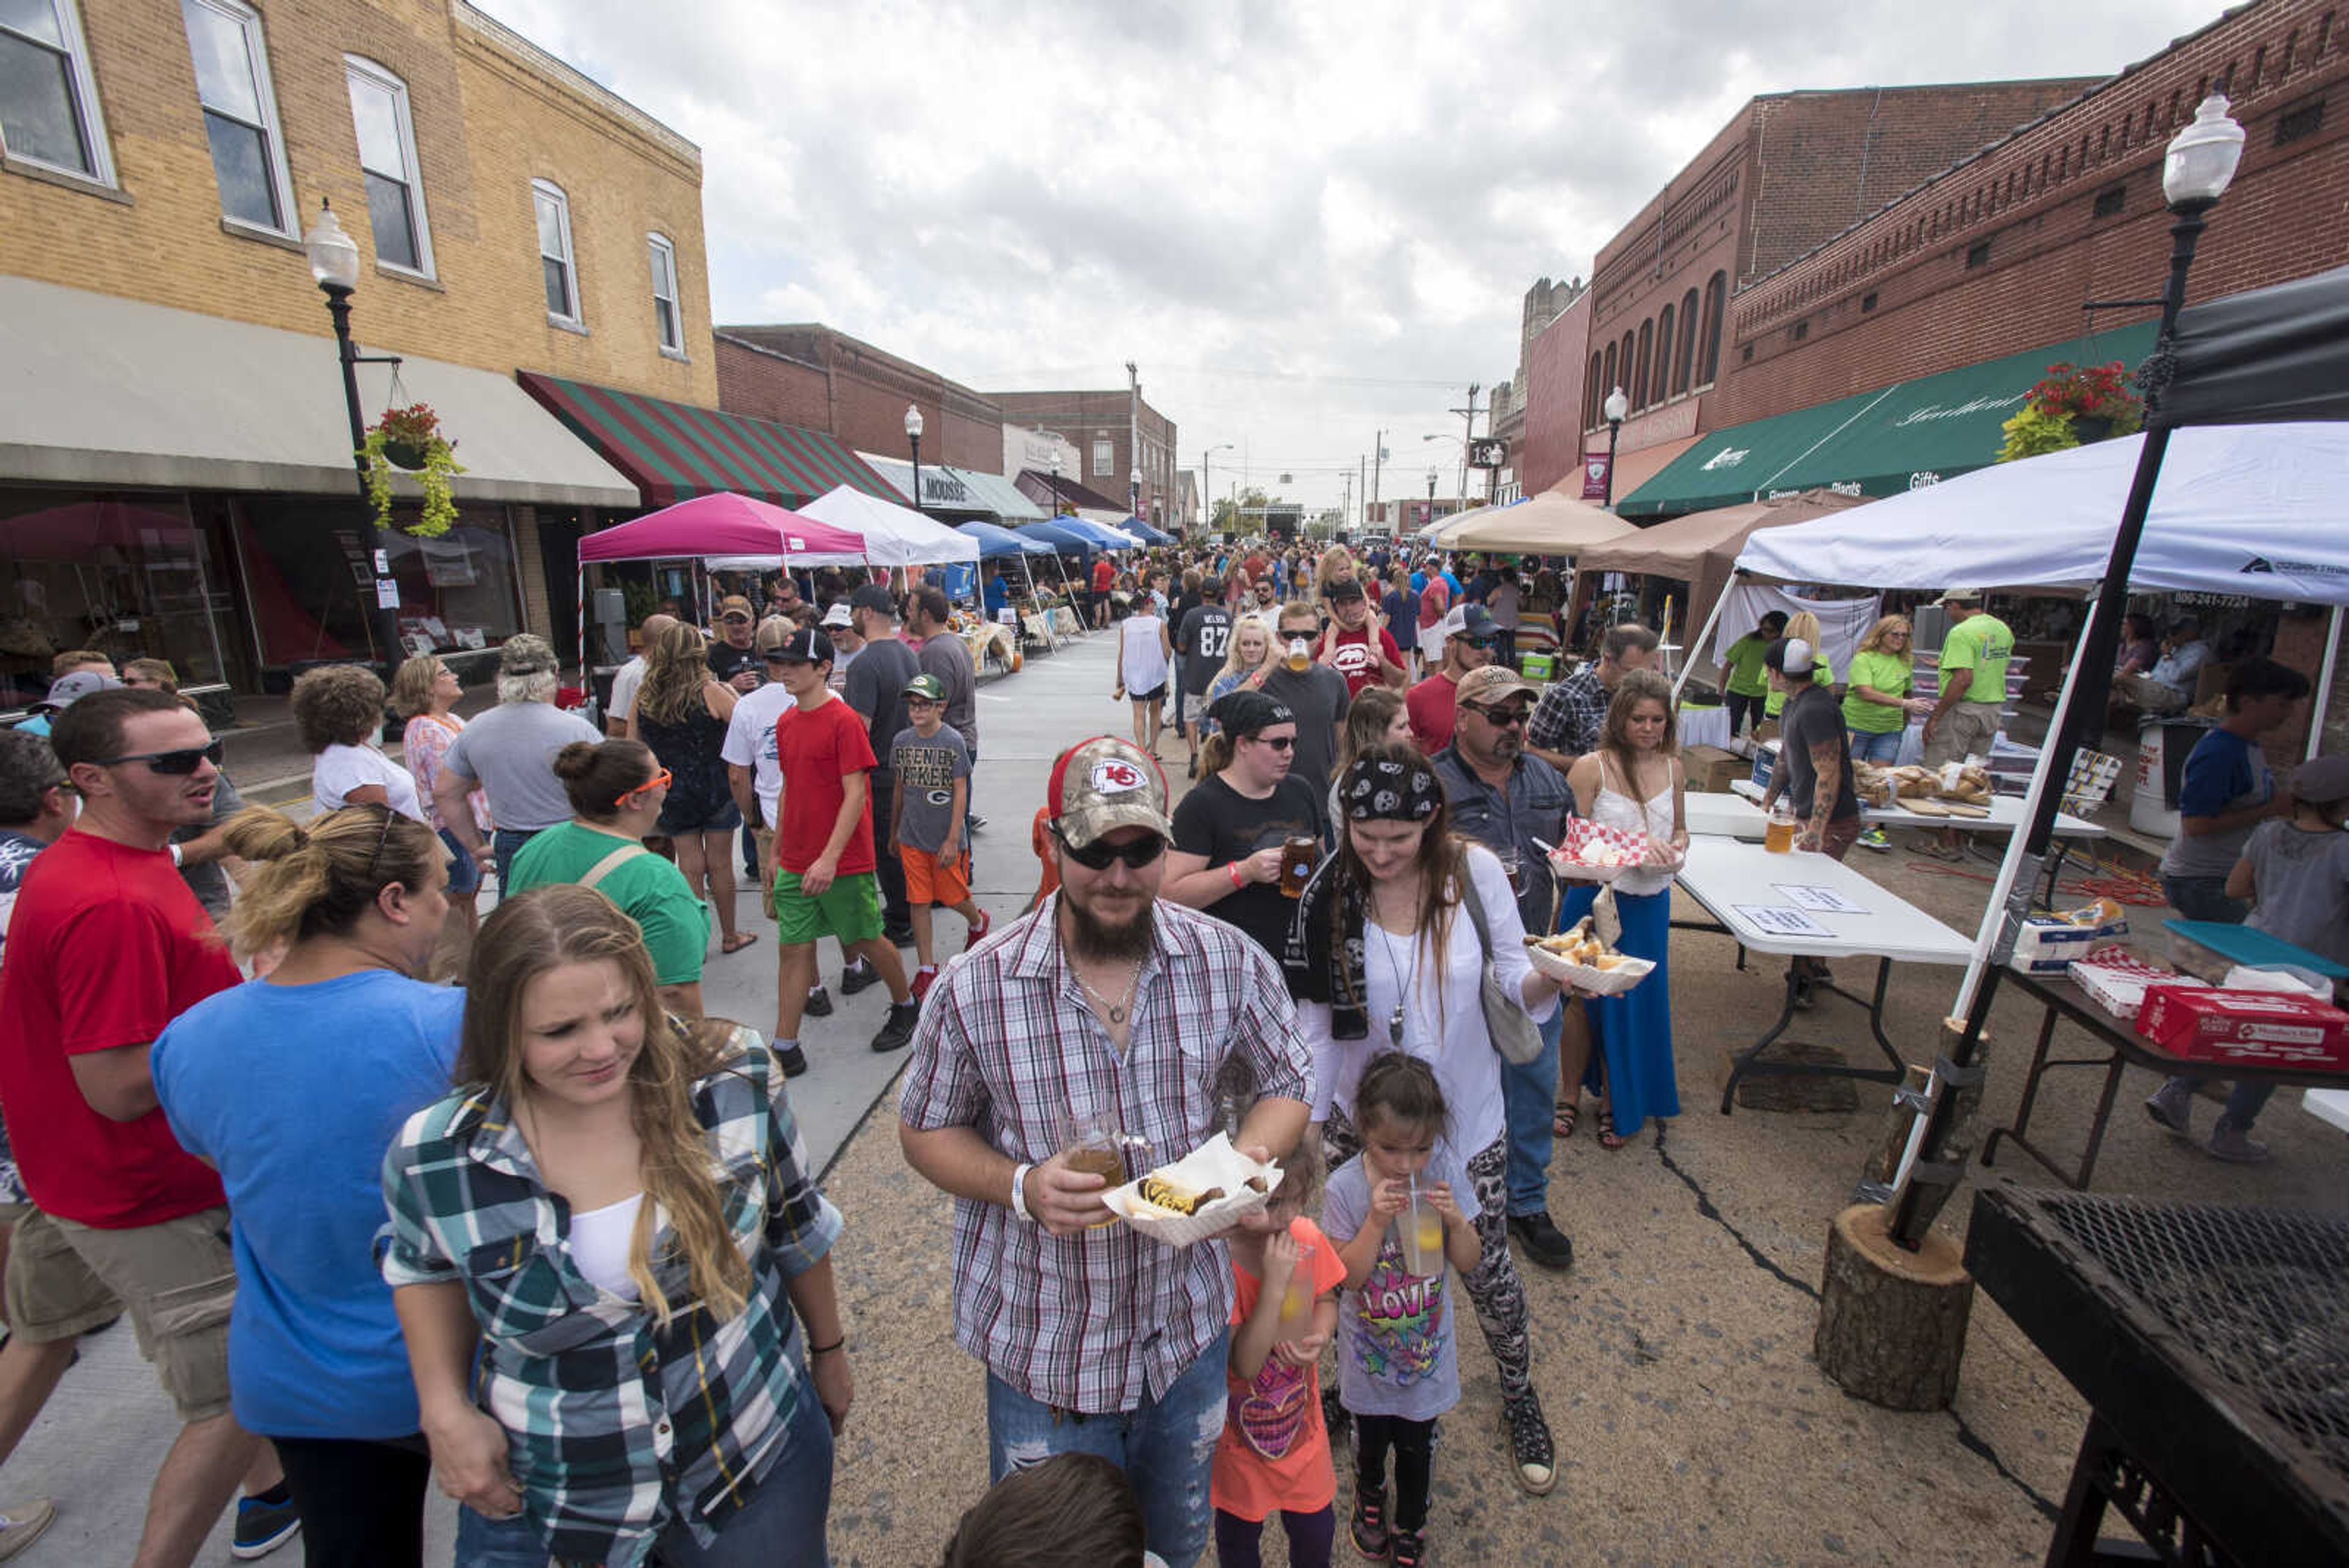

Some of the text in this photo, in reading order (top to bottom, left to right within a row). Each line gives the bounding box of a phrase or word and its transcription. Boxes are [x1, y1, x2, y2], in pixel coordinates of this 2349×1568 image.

[1910, 471, 1939, 491] Gifts
[1201, 626, 1230, 657] 87
[1362, 1276, 1438, 1319] LOVE
